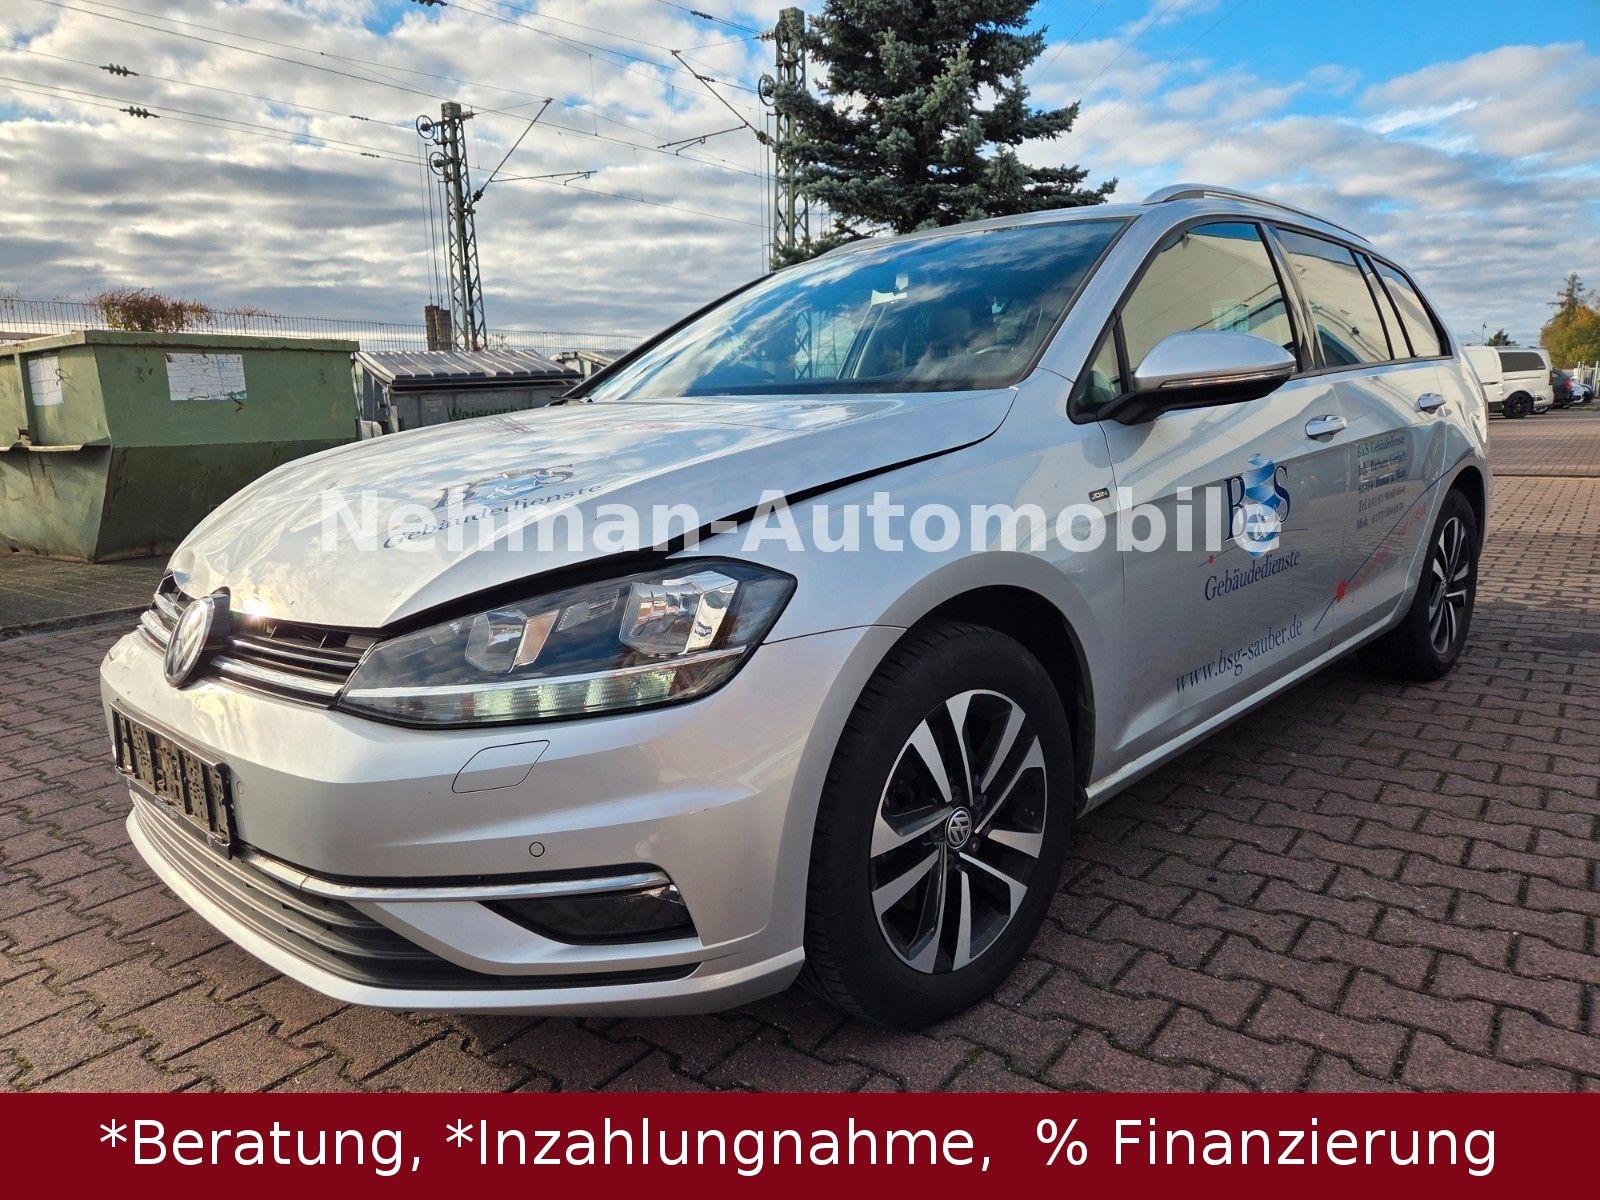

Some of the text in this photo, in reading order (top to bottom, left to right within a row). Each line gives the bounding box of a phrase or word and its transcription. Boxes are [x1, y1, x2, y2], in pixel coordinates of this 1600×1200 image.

[383, 484, 603, 550] Gebäudedienste
[1224, 465, 1291, 542] B&S
[1204, 550, 1301, 601] Gebäudedienste
[1175, 614, 1303, 693] www.bsg-sauber.de
